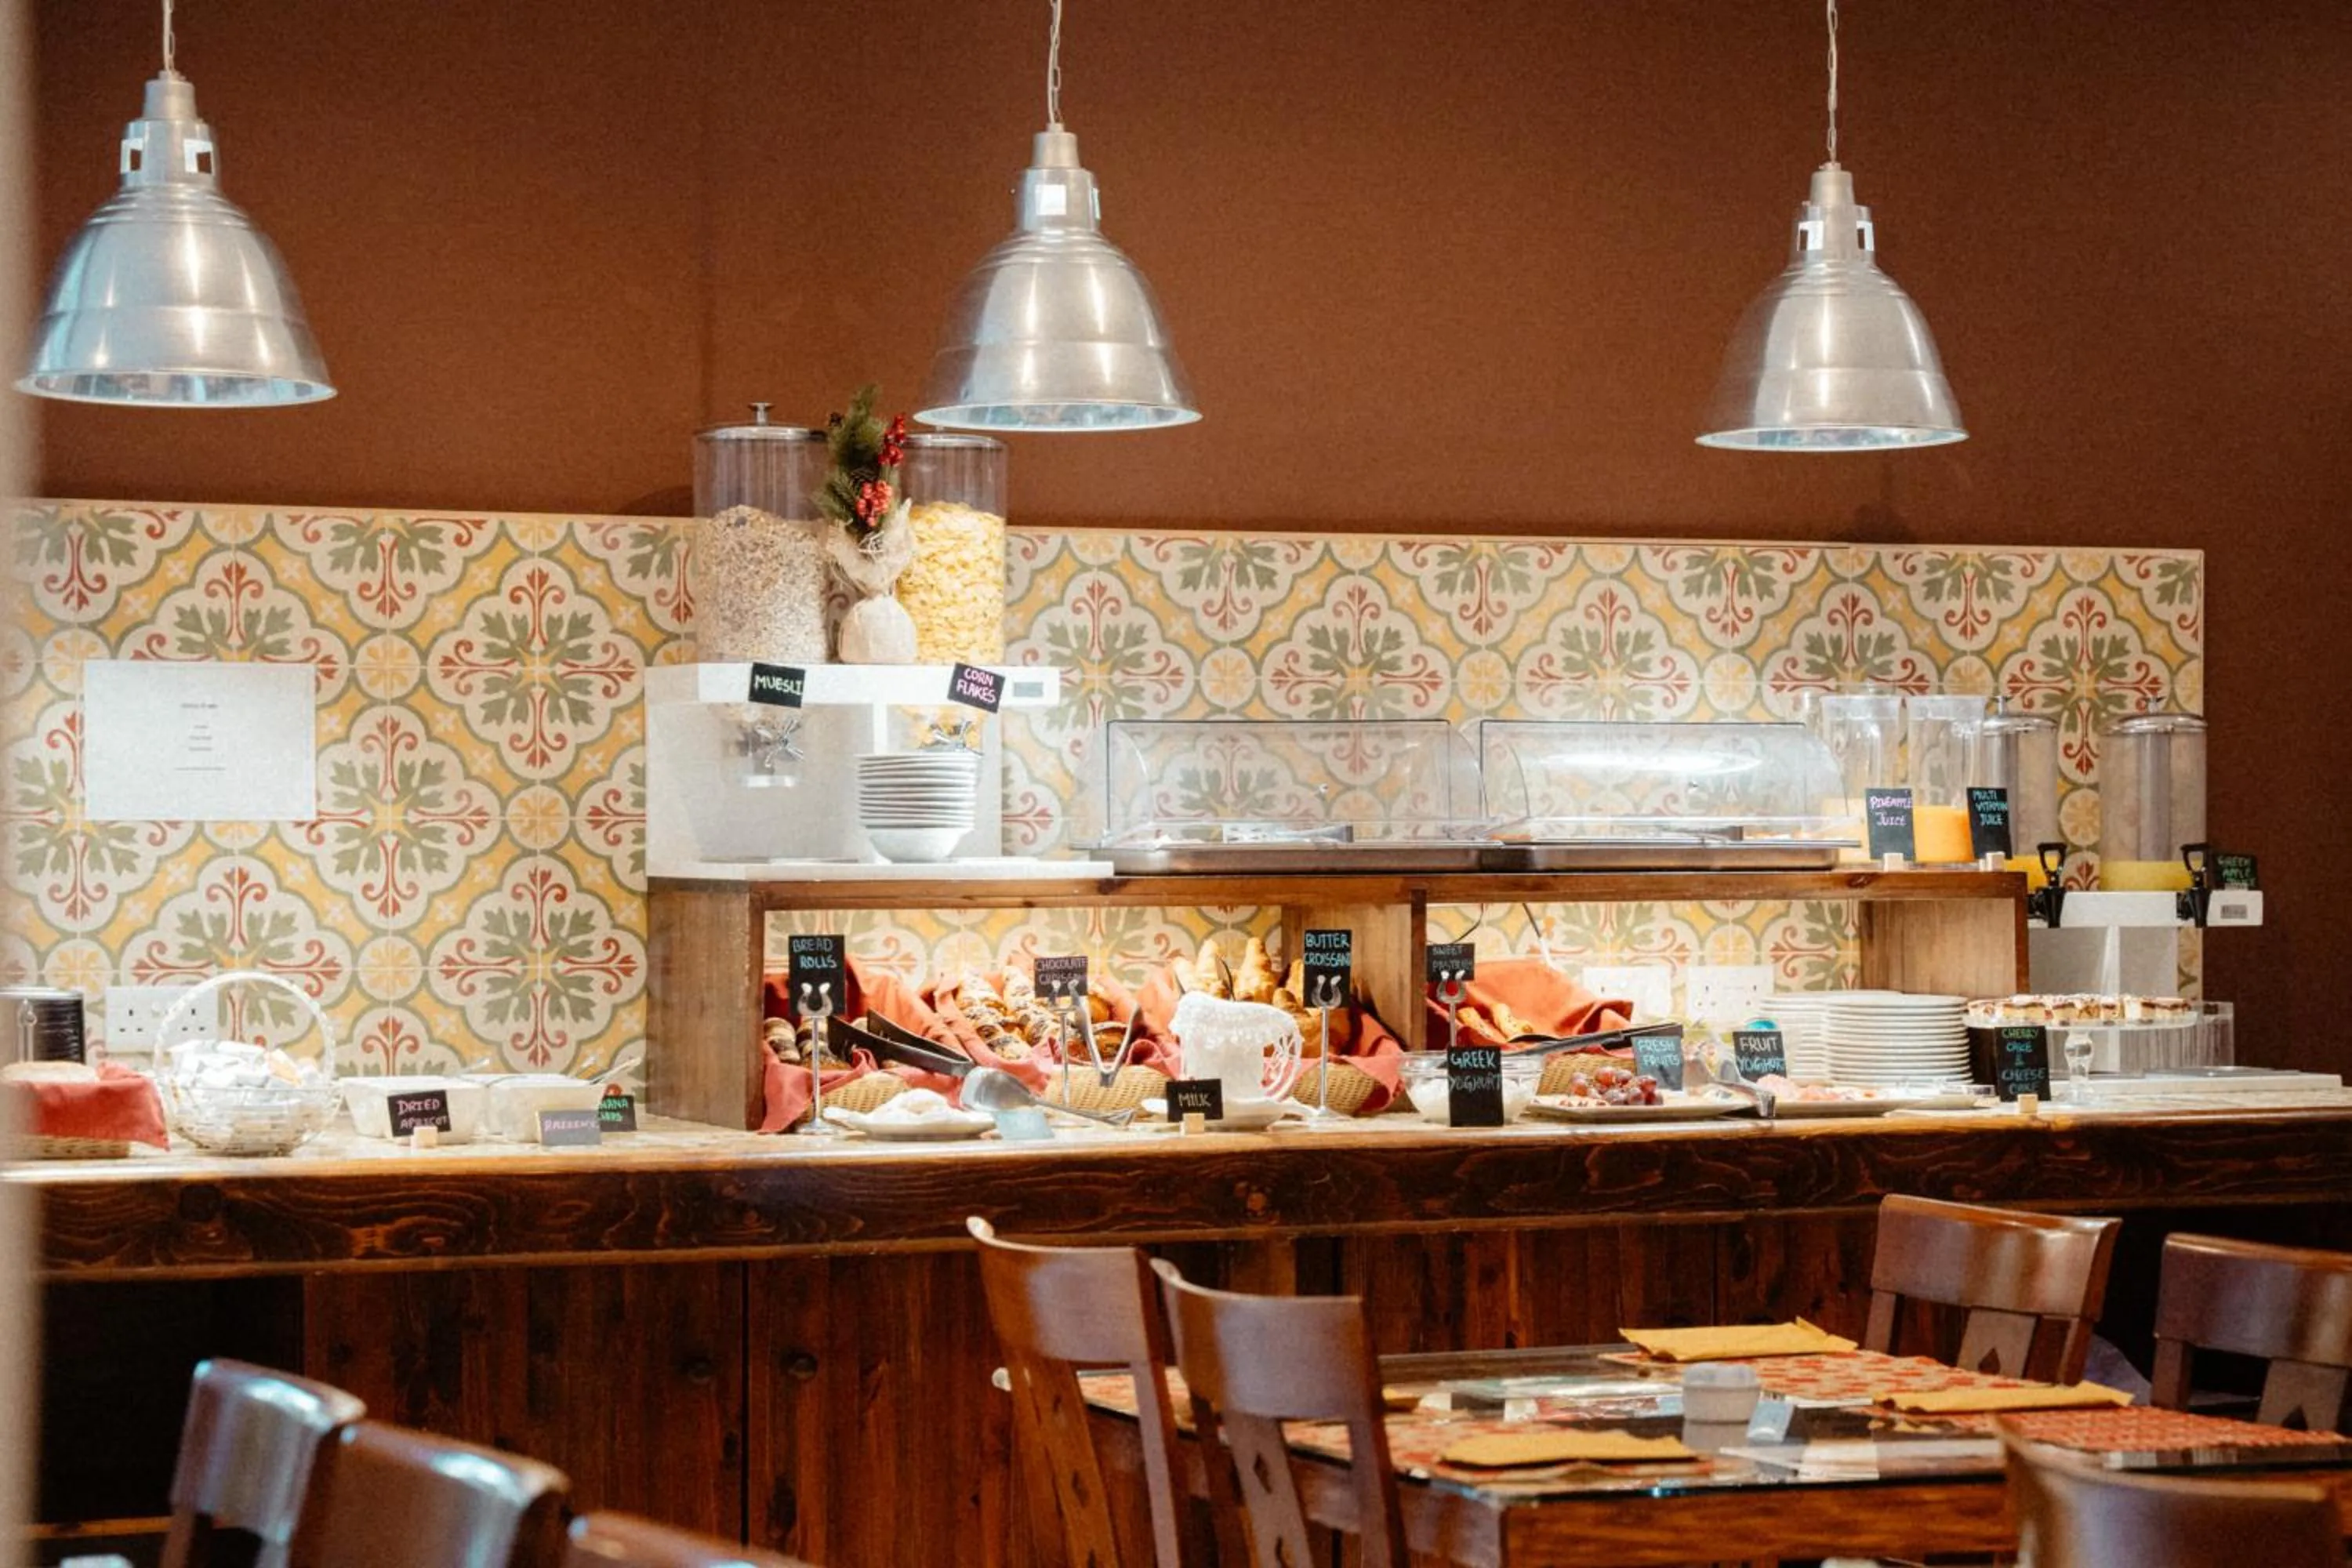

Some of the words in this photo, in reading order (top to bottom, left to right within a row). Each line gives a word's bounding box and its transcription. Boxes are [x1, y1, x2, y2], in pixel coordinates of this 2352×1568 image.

[754, 674, 803, 695] MUESLI
[964, 668, 993, 686] CORN
[956, 678, 996, 703] FLAKES
[793, 938, 833, 952] BREAD
[1305, 933, 1349, 949] BUTTER
[800, 954, 837, 969] ROLLS
[1637, 1039, 1675, 1052] FRESH
[1739, 1036, 1778, 1052] FRUIT
[1450, 1051, 1497, 1069] GREEK
[396, 1098, 440, 1115] DRIED
